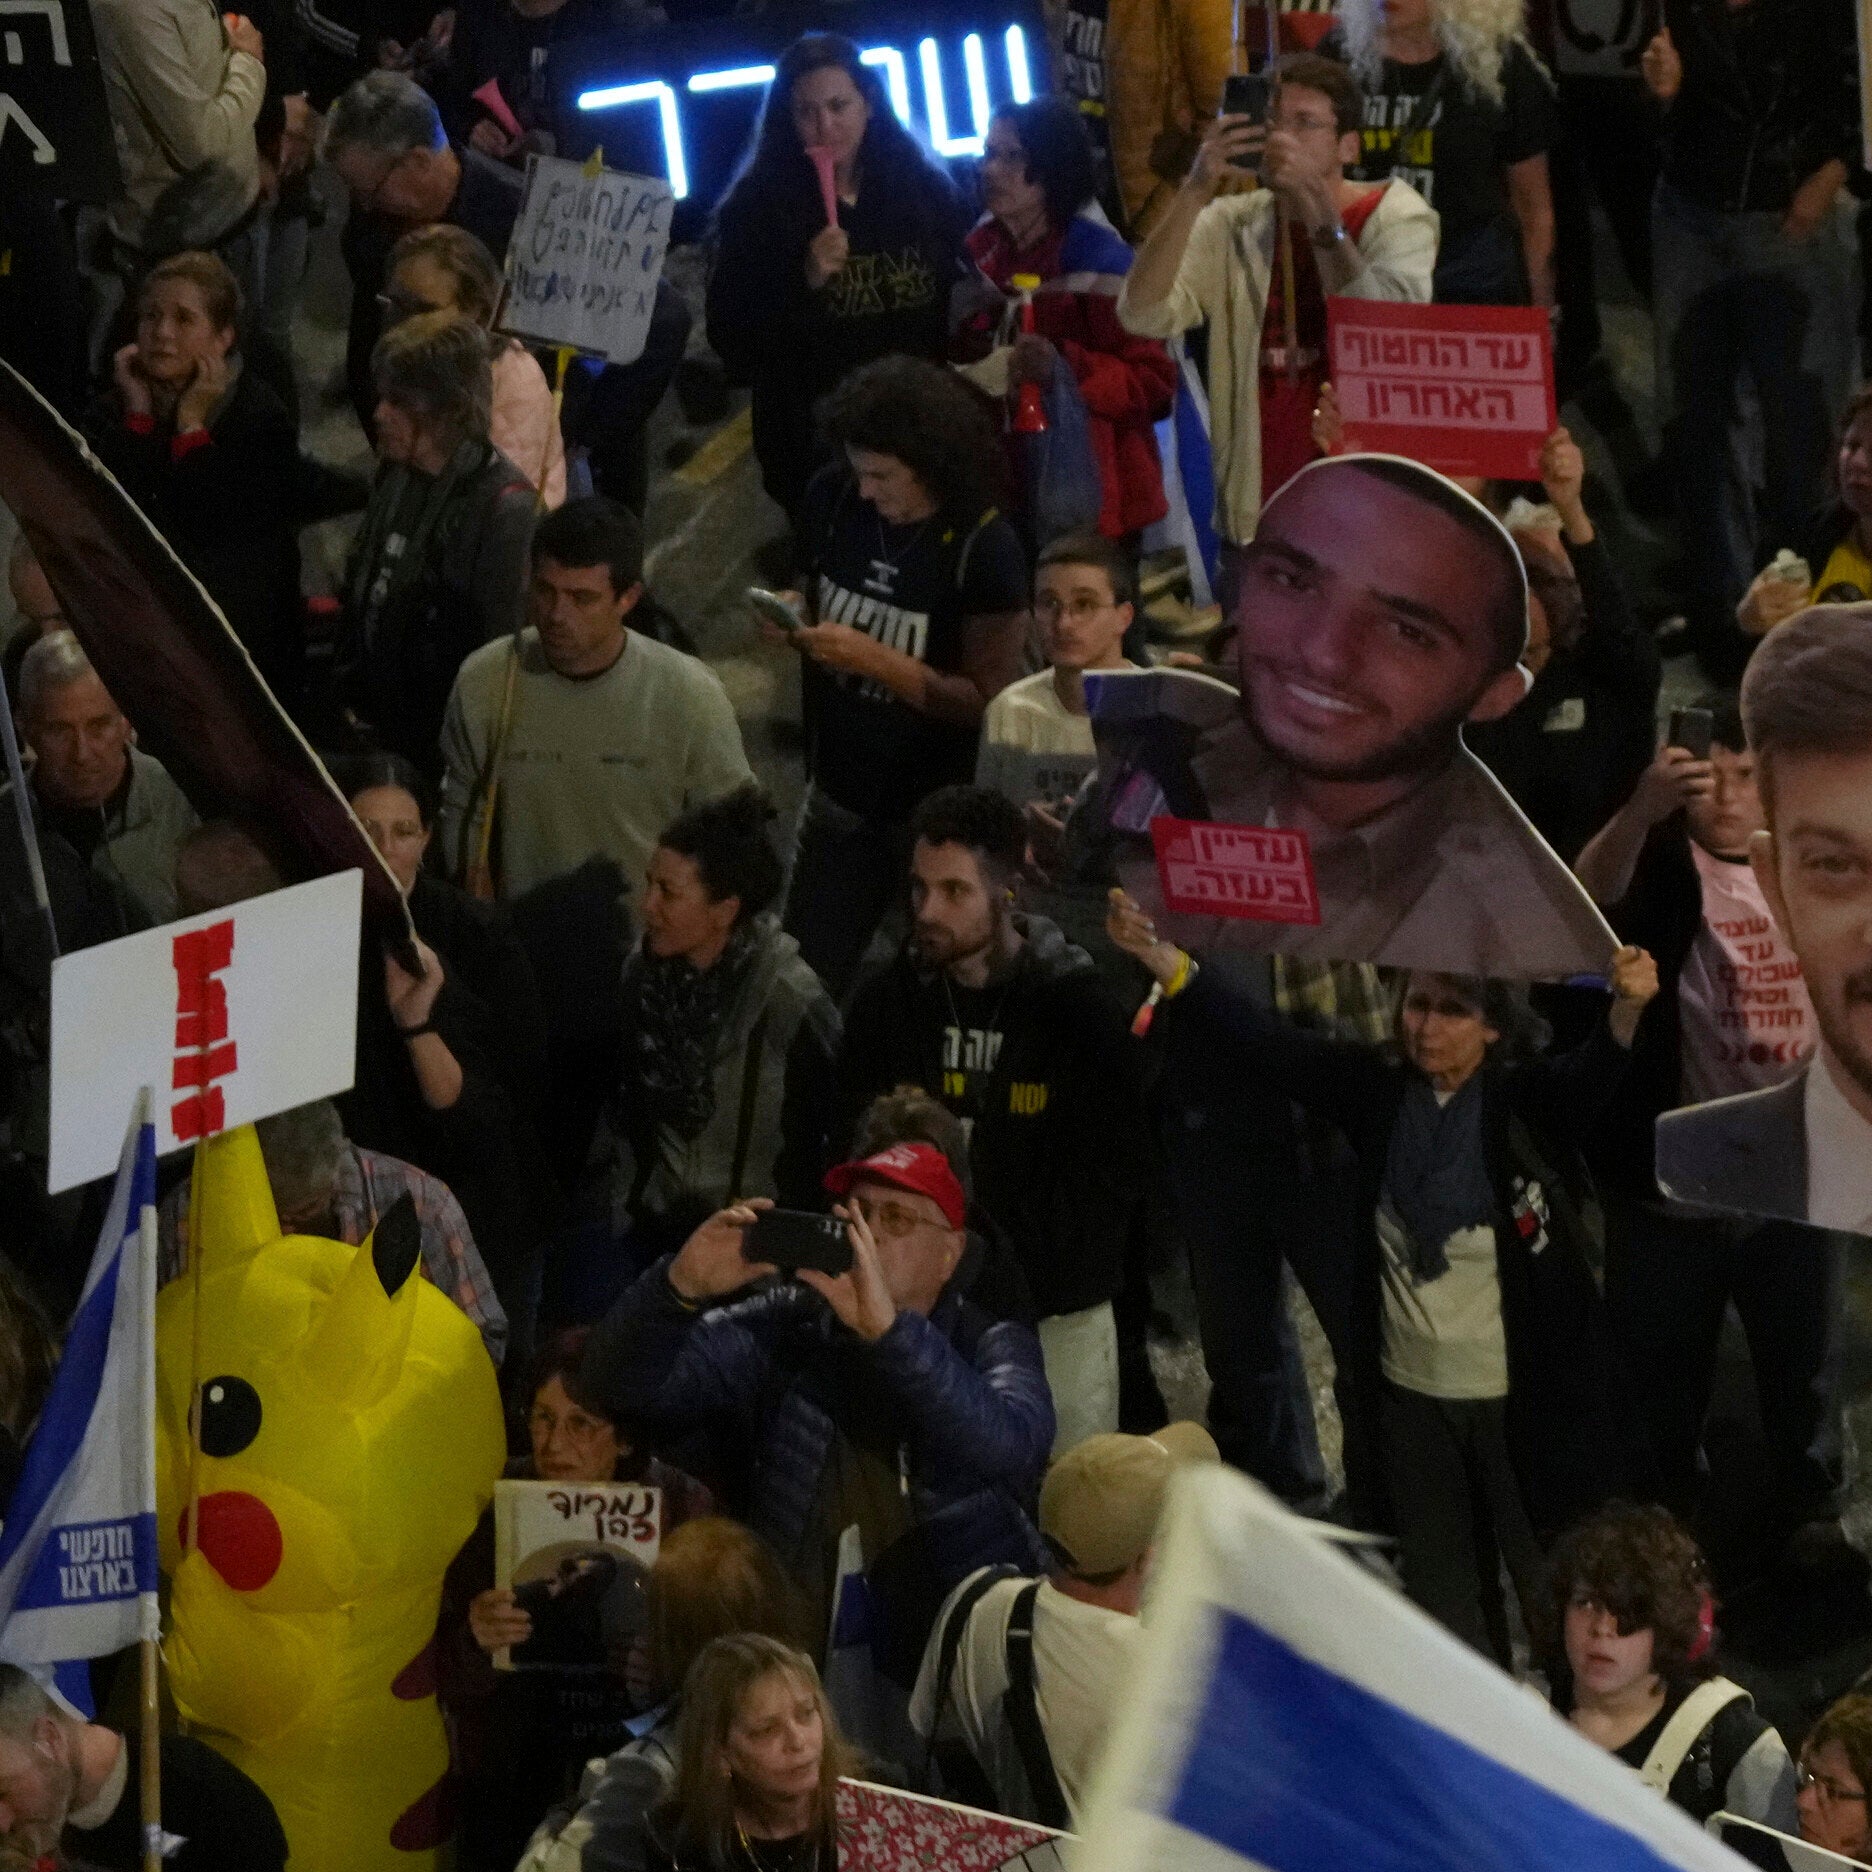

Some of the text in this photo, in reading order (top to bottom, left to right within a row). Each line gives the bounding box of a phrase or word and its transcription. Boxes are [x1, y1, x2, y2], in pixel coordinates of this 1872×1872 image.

[1342, 329, 1532, 370] עד החטוף
[1365, 380, 1515, 422] האחרון
[1200, 830, 1298, 866] עדיין
[1186, 867, 1309, 906] בעזה.
[58, 1524, 135, 1564] חופשי
[58, 1558, 139, 1599] בארצנו
